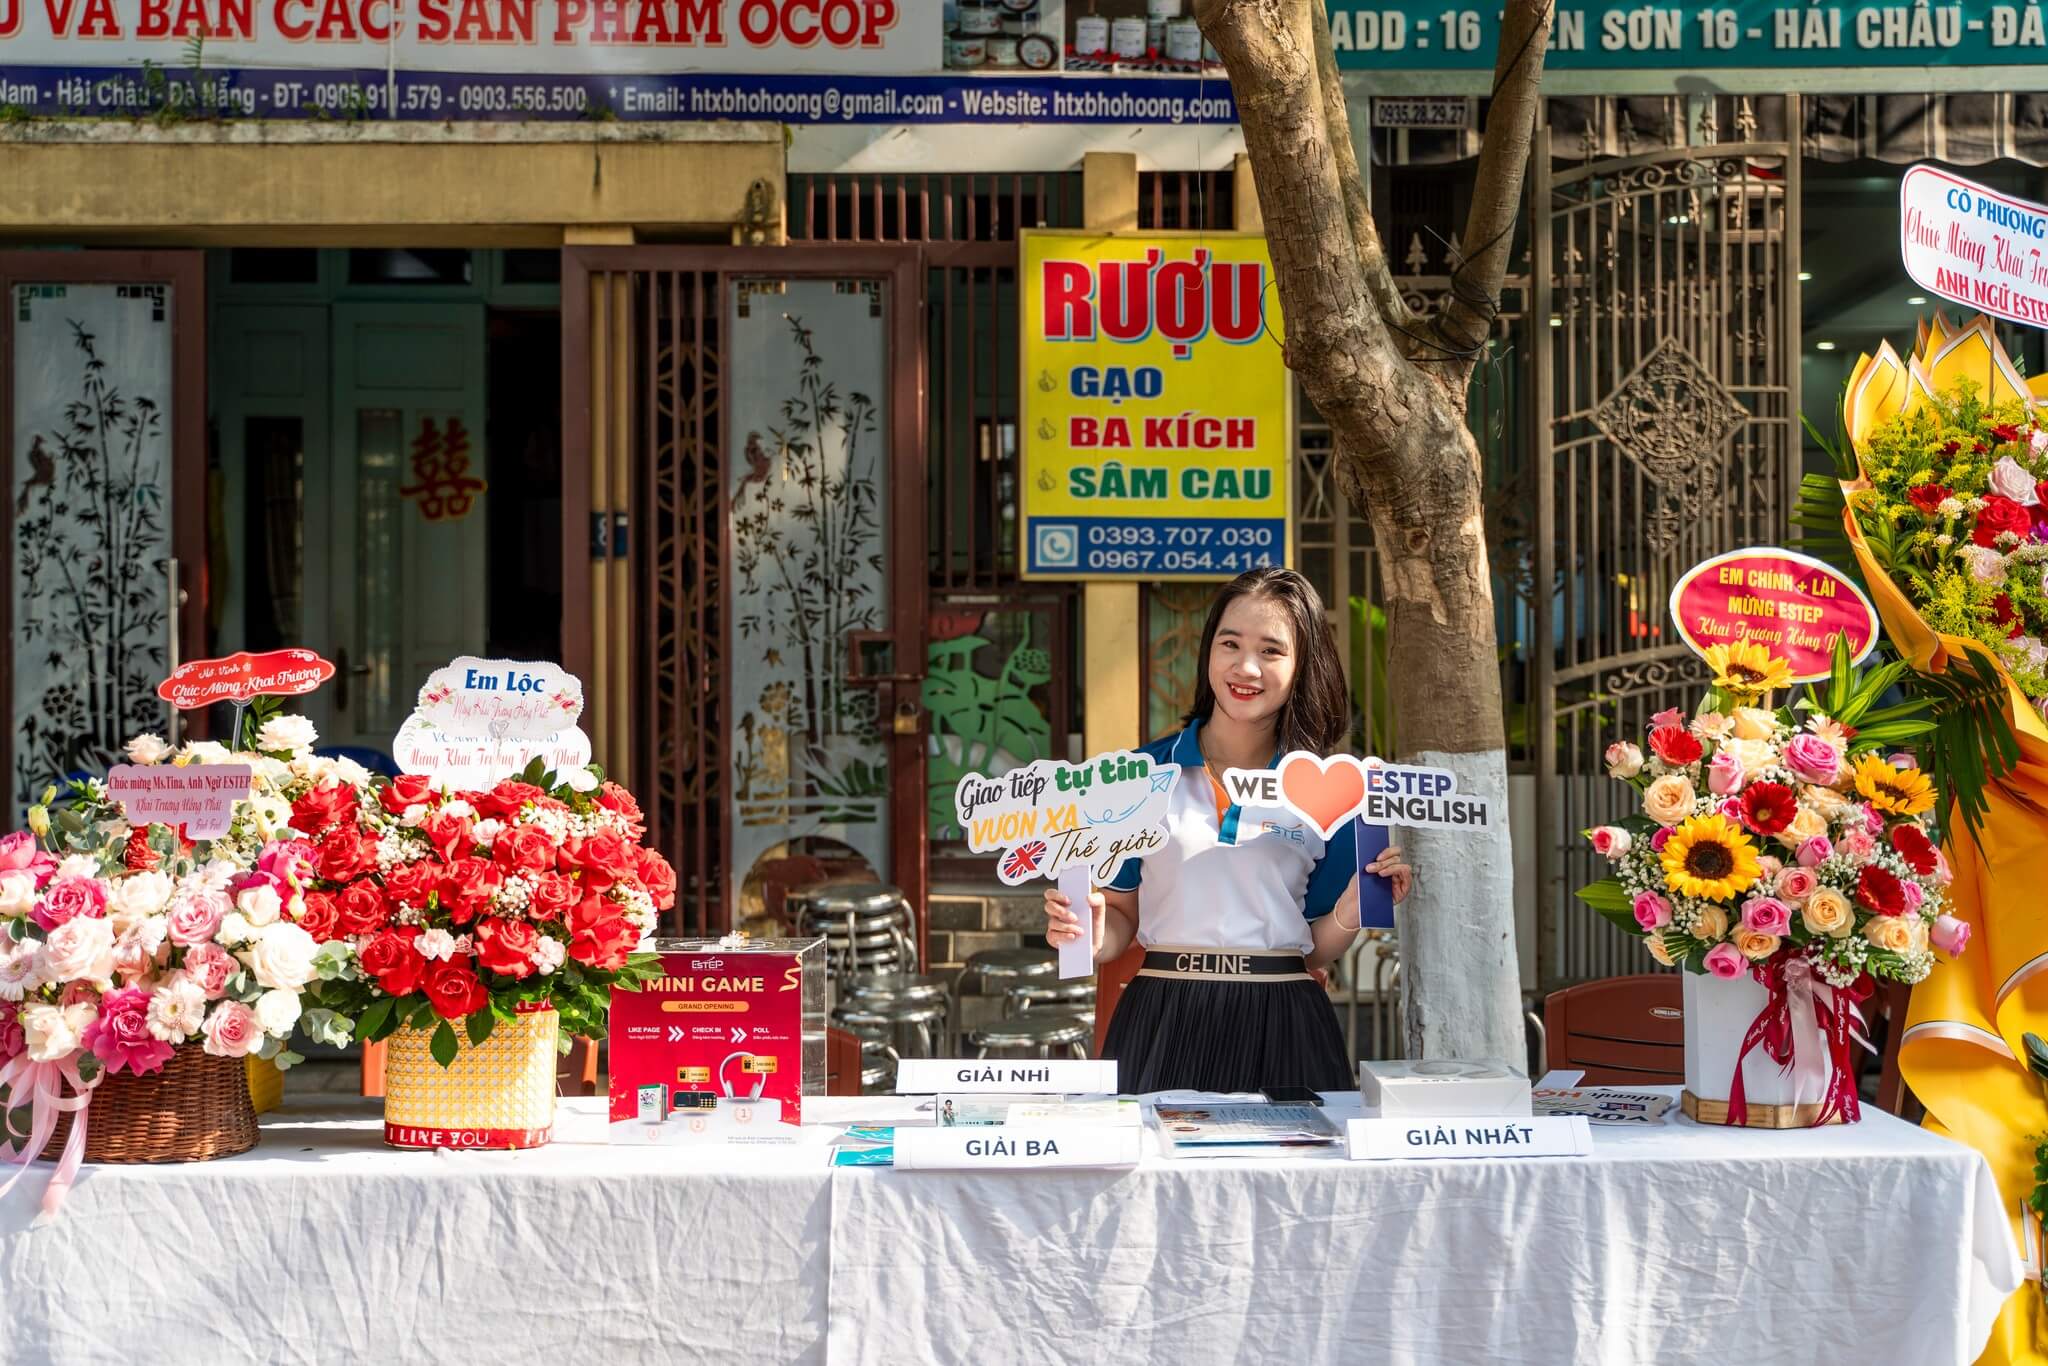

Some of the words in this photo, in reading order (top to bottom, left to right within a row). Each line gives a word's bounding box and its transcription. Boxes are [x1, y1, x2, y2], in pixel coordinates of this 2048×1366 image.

[1331, 10, 1406, 50] ADD
[1440, 11, 1481, 50] 16
[1602, 6, 1681, 50] SƠN
[1698, 9, 1738, 49] 16
[1857, 0, 1961, 47] CHÂU
[57, 76, 91, 105] Hải
[97, 78, 150, 106] Châu
[169, 82, 195, 106] Đà
[460, 85, 586, 112] 0903.556.500
[624, 86, 685, 112] Email:
[692, 87, 944, 120] htxbhohoong@gmail.com
[961, 90, 1048, 116] Website:
[1053, 91, 1232, 123] htxbhohoong.com
[1378, 105, 1465, 125] 0935.28.29.27
[1947, 187, 1972, 213] CÔ
[1977, 197, 2047, 239] PHƯỢNG
[1906, 206, 1941, 251] Chúc
[1990, 234, 2025, 280] Khai
[1042, 248, 1265, 360] RƯỢU
[1936, 266, 1970, 300] ANH
[1974, 278, 2010, 313] NGỮ
[1069, 366, 1164, 404] GẠO
[1069, 417, 1132, 448] BA
[1144, 411, 1256, 449] KÍCH
[1068, 461, 1168, 499] SÂM
[1181, 467, 1272, 500] CAU
[1088, 526, 1273, 547] 0393.707.030
[1088, 551, 1272, 570] 0967.054.414
[1719, 567, 1744, 586] EM
[1748, 568, 1794, 593] CHÍNH
[1811, 576, 1836, 599] LÀI
[1728, 595, 1775, 618] MỪNG
[1778, 604, 1824, 625] ESTEP
[1696, 616, 1730, 638] Khai
[172, 682, 201, 698] Chúc
[242, 676, 275, 692] Khai
[277, 667, 322, 685] Trương
[465, 668, 498, 689] Em
[506, 671, 546, 696] Lộc
[108, 775, 129, 790] Chúc
[187, 777, 203, 790] Anh
[223, 776, 251, 790] ESTEP
[960, 779, 1006, 821] Giao
[1009, 765, 1050, 806] tiếp
[1054, 764, 1094, 796] tự
[1099, 756, 1149, 787] tin
[1230, 775, 1278, 801] WE
[1367, 769, 1452, 797] ESTEP
[972, 809, 1039, 847] VƯƠN
[1043, 803, 1081, 834] XA
[1368, 795, 1487, 826] ENGLISH
[1049, 826, 1100, 873] Thế
[1097, 829, 1163, 880] giới
[1175, 953, 1251, 975] CELINE
[646, 976, 695, 993] MINI
[701, 976, 765, 993] GAME
[956, 1065, 1003, 1083] GIẢI
[450, 1131, 489, 1146] YOU
[966, 1136, 1016, 1157] GIẢI
[1026, 1139, 1060, 1157] BA
[1406, 1125, 1457, 1146] GIẢI
[1465, 1124, 1534, 1145] NHẤT
